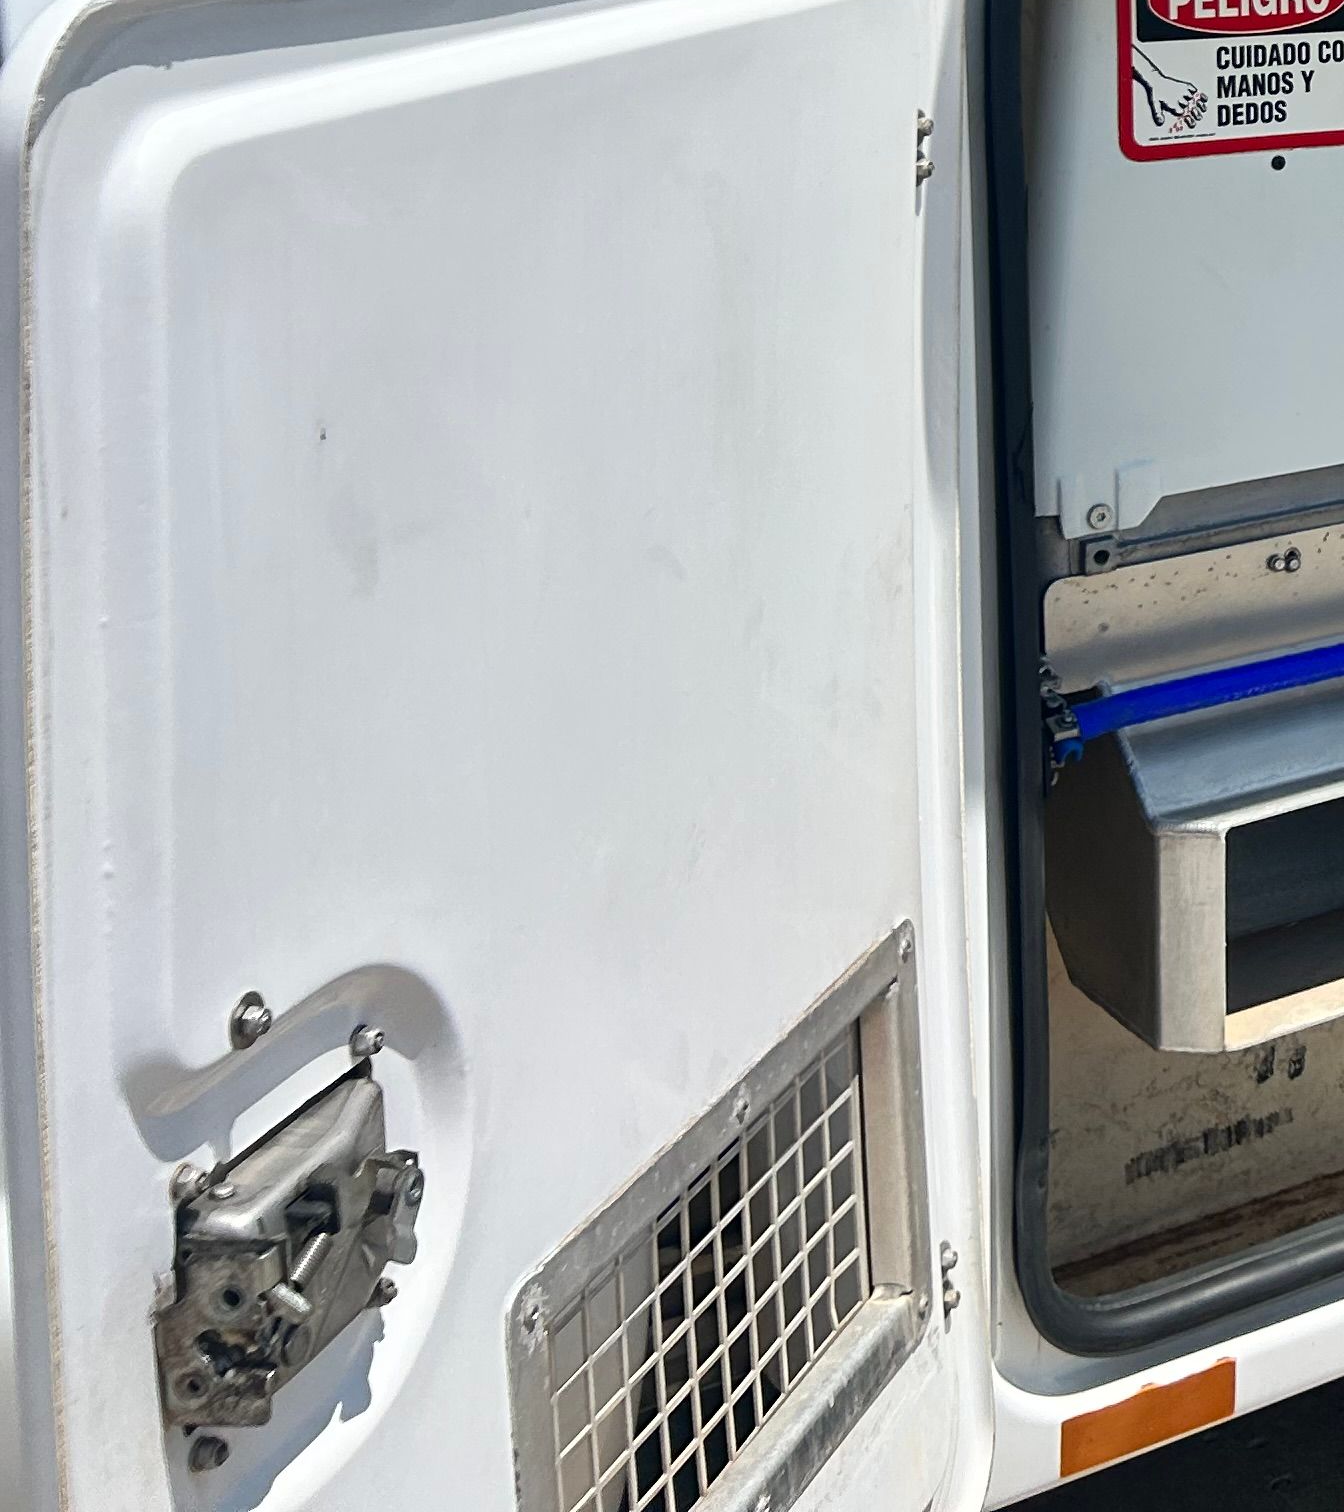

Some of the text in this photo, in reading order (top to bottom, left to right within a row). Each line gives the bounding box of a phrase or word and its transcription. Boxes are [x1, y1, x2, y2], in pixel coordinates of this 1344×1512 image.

[1216, 43, 1311, 70] CUIDADO
[1216, 70, 1315, 99] MANOS Y
[1217, 100, 1287, 127] DEDOS
